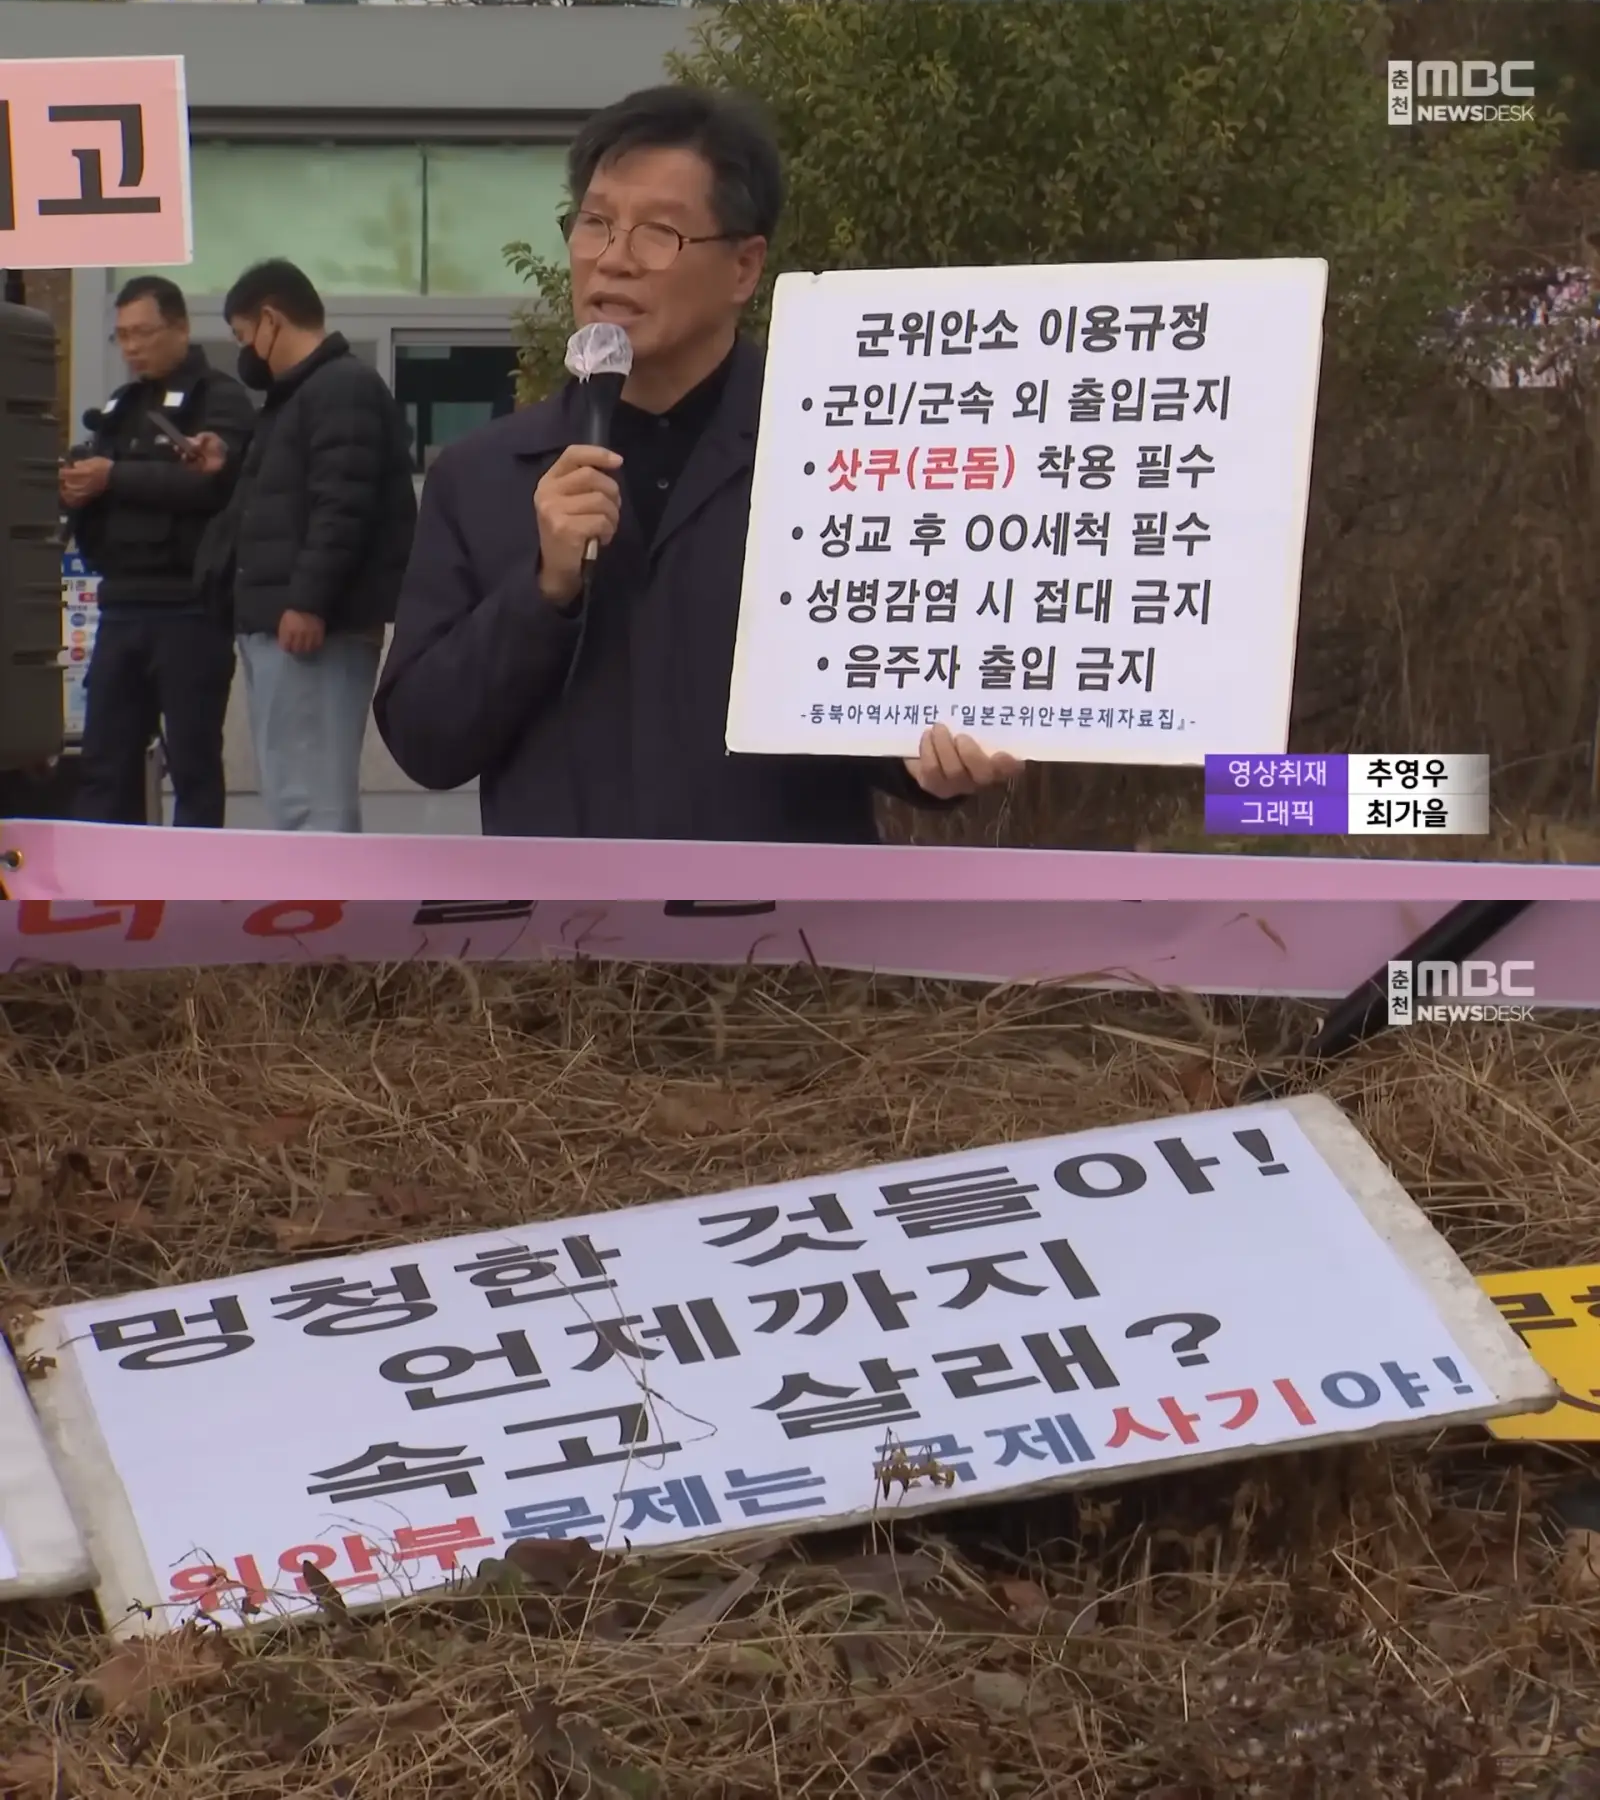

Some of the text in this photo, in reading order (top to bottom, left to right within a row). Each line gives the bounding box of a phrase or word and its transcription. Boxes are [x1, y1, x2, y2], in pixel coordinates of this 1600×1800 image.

[855, 302, 1209, 357] 군위안소 이용규정
[823, 375, 1231, 426] 군인/군속 외 출입금지
[827, 444, 1216, 492] 삿쿠(콘돔) 착용 필수
[820, 513, 892, 558] 성교
[909, 512, 946, 556] 후
[1132, 511, 1211, 556] 필수
[807, 578, 1211, 624] 성병감염 시 접대 금지
[845, 644, 1156, 691] 음주자 출입 금지
[90, 1127, 1290, 1371] 멍청한 것들아!
[379, 1237, 1101, 1411] 언제까지
[307, 1311, 1222, 1505] 속고 살래?
[169, 1355, 1475, 1612] 위안부문제는 국제사기야!
